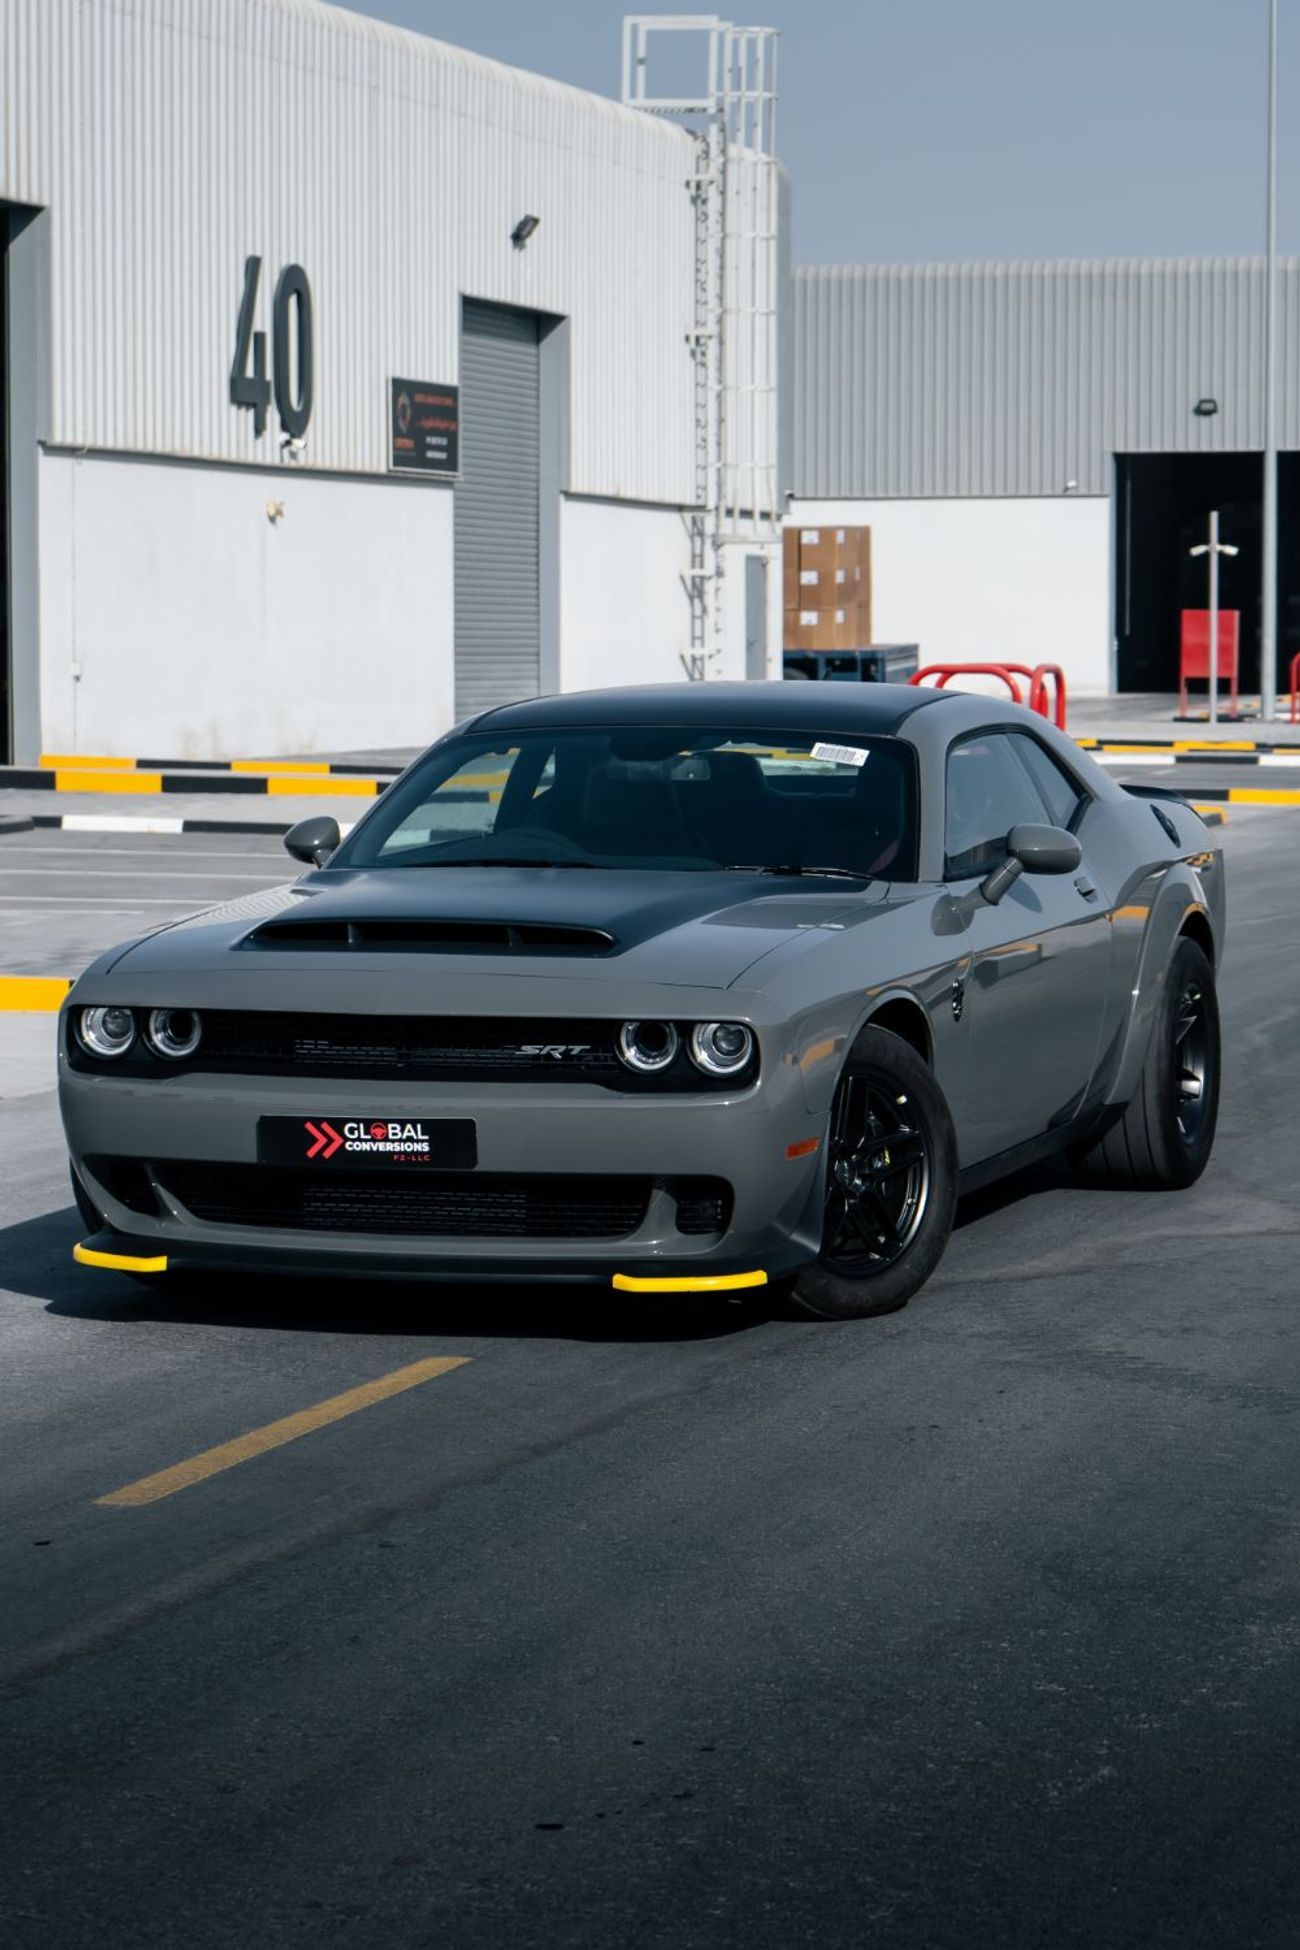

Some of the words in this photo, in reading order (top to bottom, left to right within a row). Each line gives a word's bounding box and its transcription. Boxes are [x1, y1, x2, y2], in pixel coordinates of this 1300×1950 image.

[230, 255, 313, 440] 40
[515, 1045, 592, 1059] SRT
[344, 1122, 429, 1140] GLOBAL
[345, 1141, 430, 1152] CONVERSIONS
